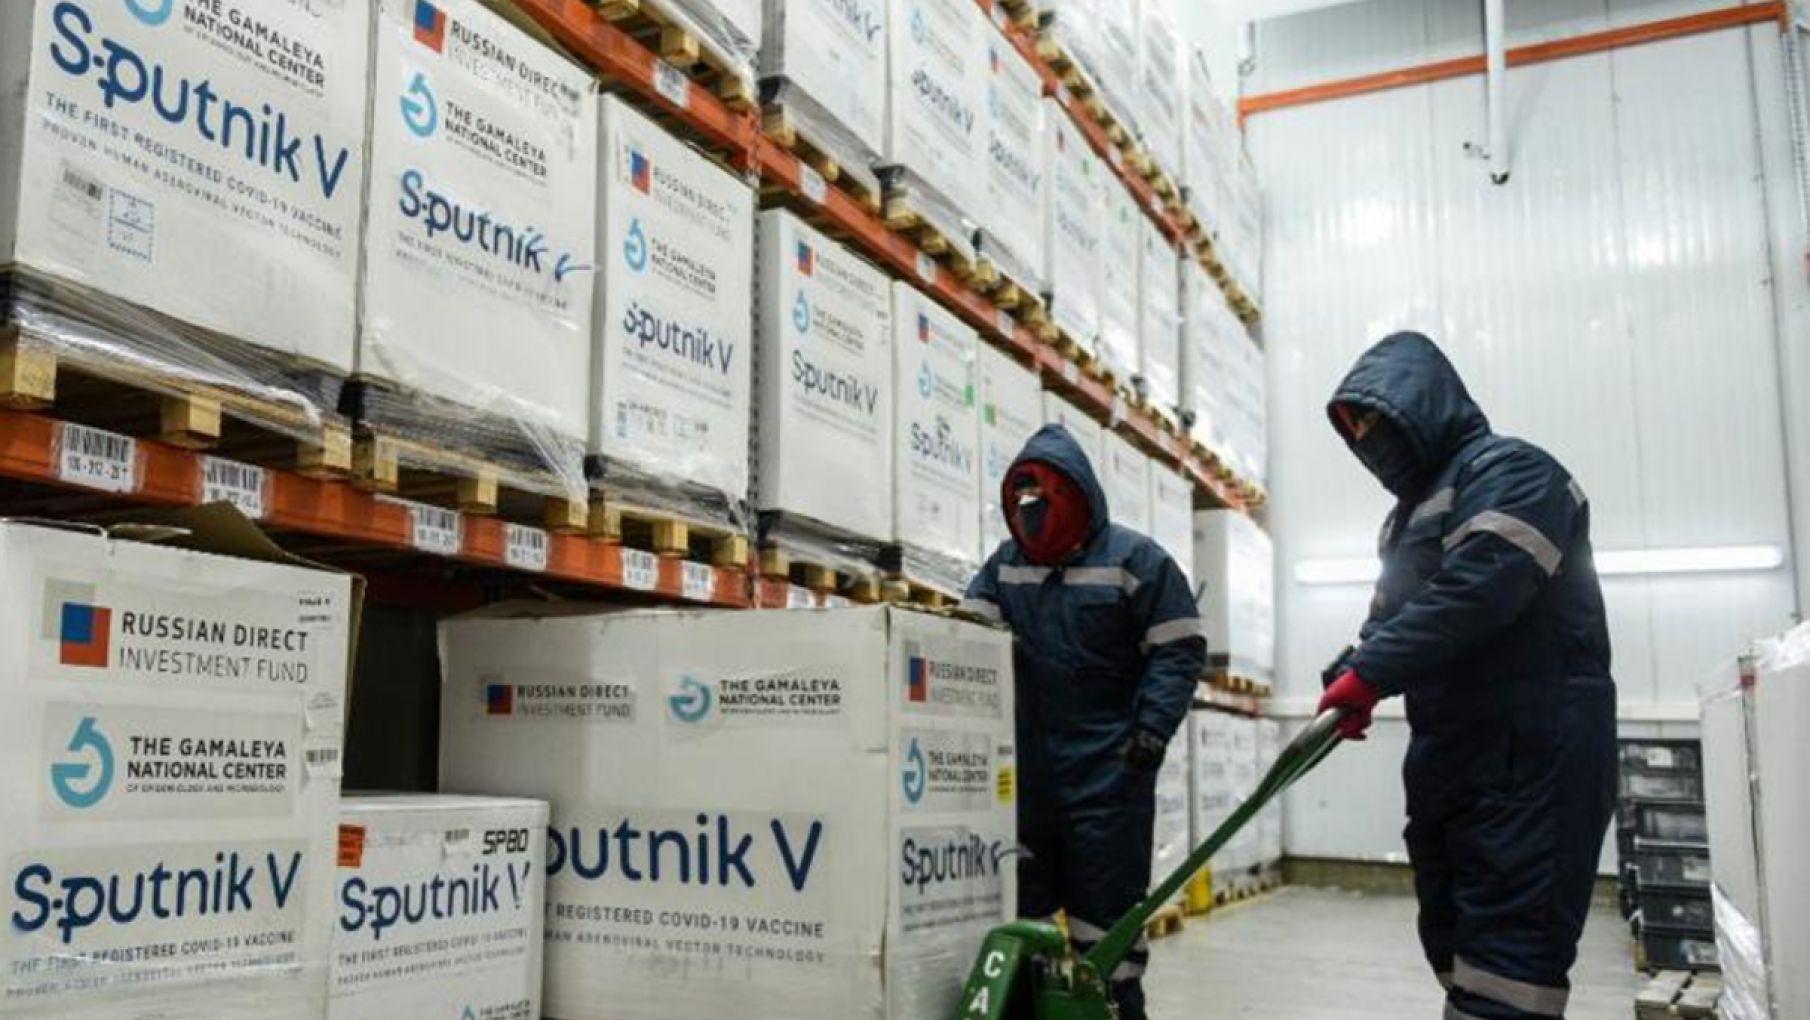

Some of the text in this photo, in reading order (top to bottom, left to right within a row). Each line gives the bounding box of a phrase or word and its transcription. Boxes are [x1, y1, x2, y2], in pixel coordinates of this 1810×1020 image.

[184, 5, 264, 57] NATIONAL
[267, 49, 325, 88] CENTER
[194, 0, 222, 17] HE
[228, 8, 325, 70] GAMALEYA
[451, 20, 516, 71] RUSSIAN
[50, 2, 301, 182] Sputnik
[313, 134, 349, 199] V
[445, 118, 502, 157] NATIONAL
[504, 148, 547, 176] CENTER
[446, 101, 472, 124] THE
[475, 117, 546, 161] GAMALEYA
[46, 91, 79, 118] THE
[83, 110, 129, 140] FIRST
[134, 132, 221, 184] REGISTERED
[290, 205, 342, 241] VACCINE
[400, 168, 546, 273] Sputnik
[624, 301, 733, 374] Sputnik V
[792, 350, 862, 412] Sputnik
[864, 384, 878, 415] V
[121, 611, 309, 652] RUSSIAN DIRECT
[119, 646, 308, 684] INVESTMENT FUND
[517, 684, 629, 698] RUSSIAN DIRECT
[720, 679, 841, 692] THE GAMALEYA
[516, 702, 631, 718] INVESTMENT FUND
[719, 693, 841, 706] NATIONAL CENTER
[127, 762, 287, 780] NATIONAL CENTER
[130, 736, 287, 758] THE GAMALEYA
[771, 818, 823, 891] V
[902, 832, 986, 895] Sputnik
[12, 851, 302, 944] Sputnik V
[340, 861, 530, 940] Sputnik V
[556, 903, 653, 925] REGISTERED
[659, 911, 739, 931] COVID-19
[746, 916, 824, 938] VACCINE
[180, 936, 240, 956] COVID-19
[243, 928, 294, 947] VACCINE
[666, 938, 721, 953] VECTOR
[727, 943, 824, 963] TECHNOLOGY
